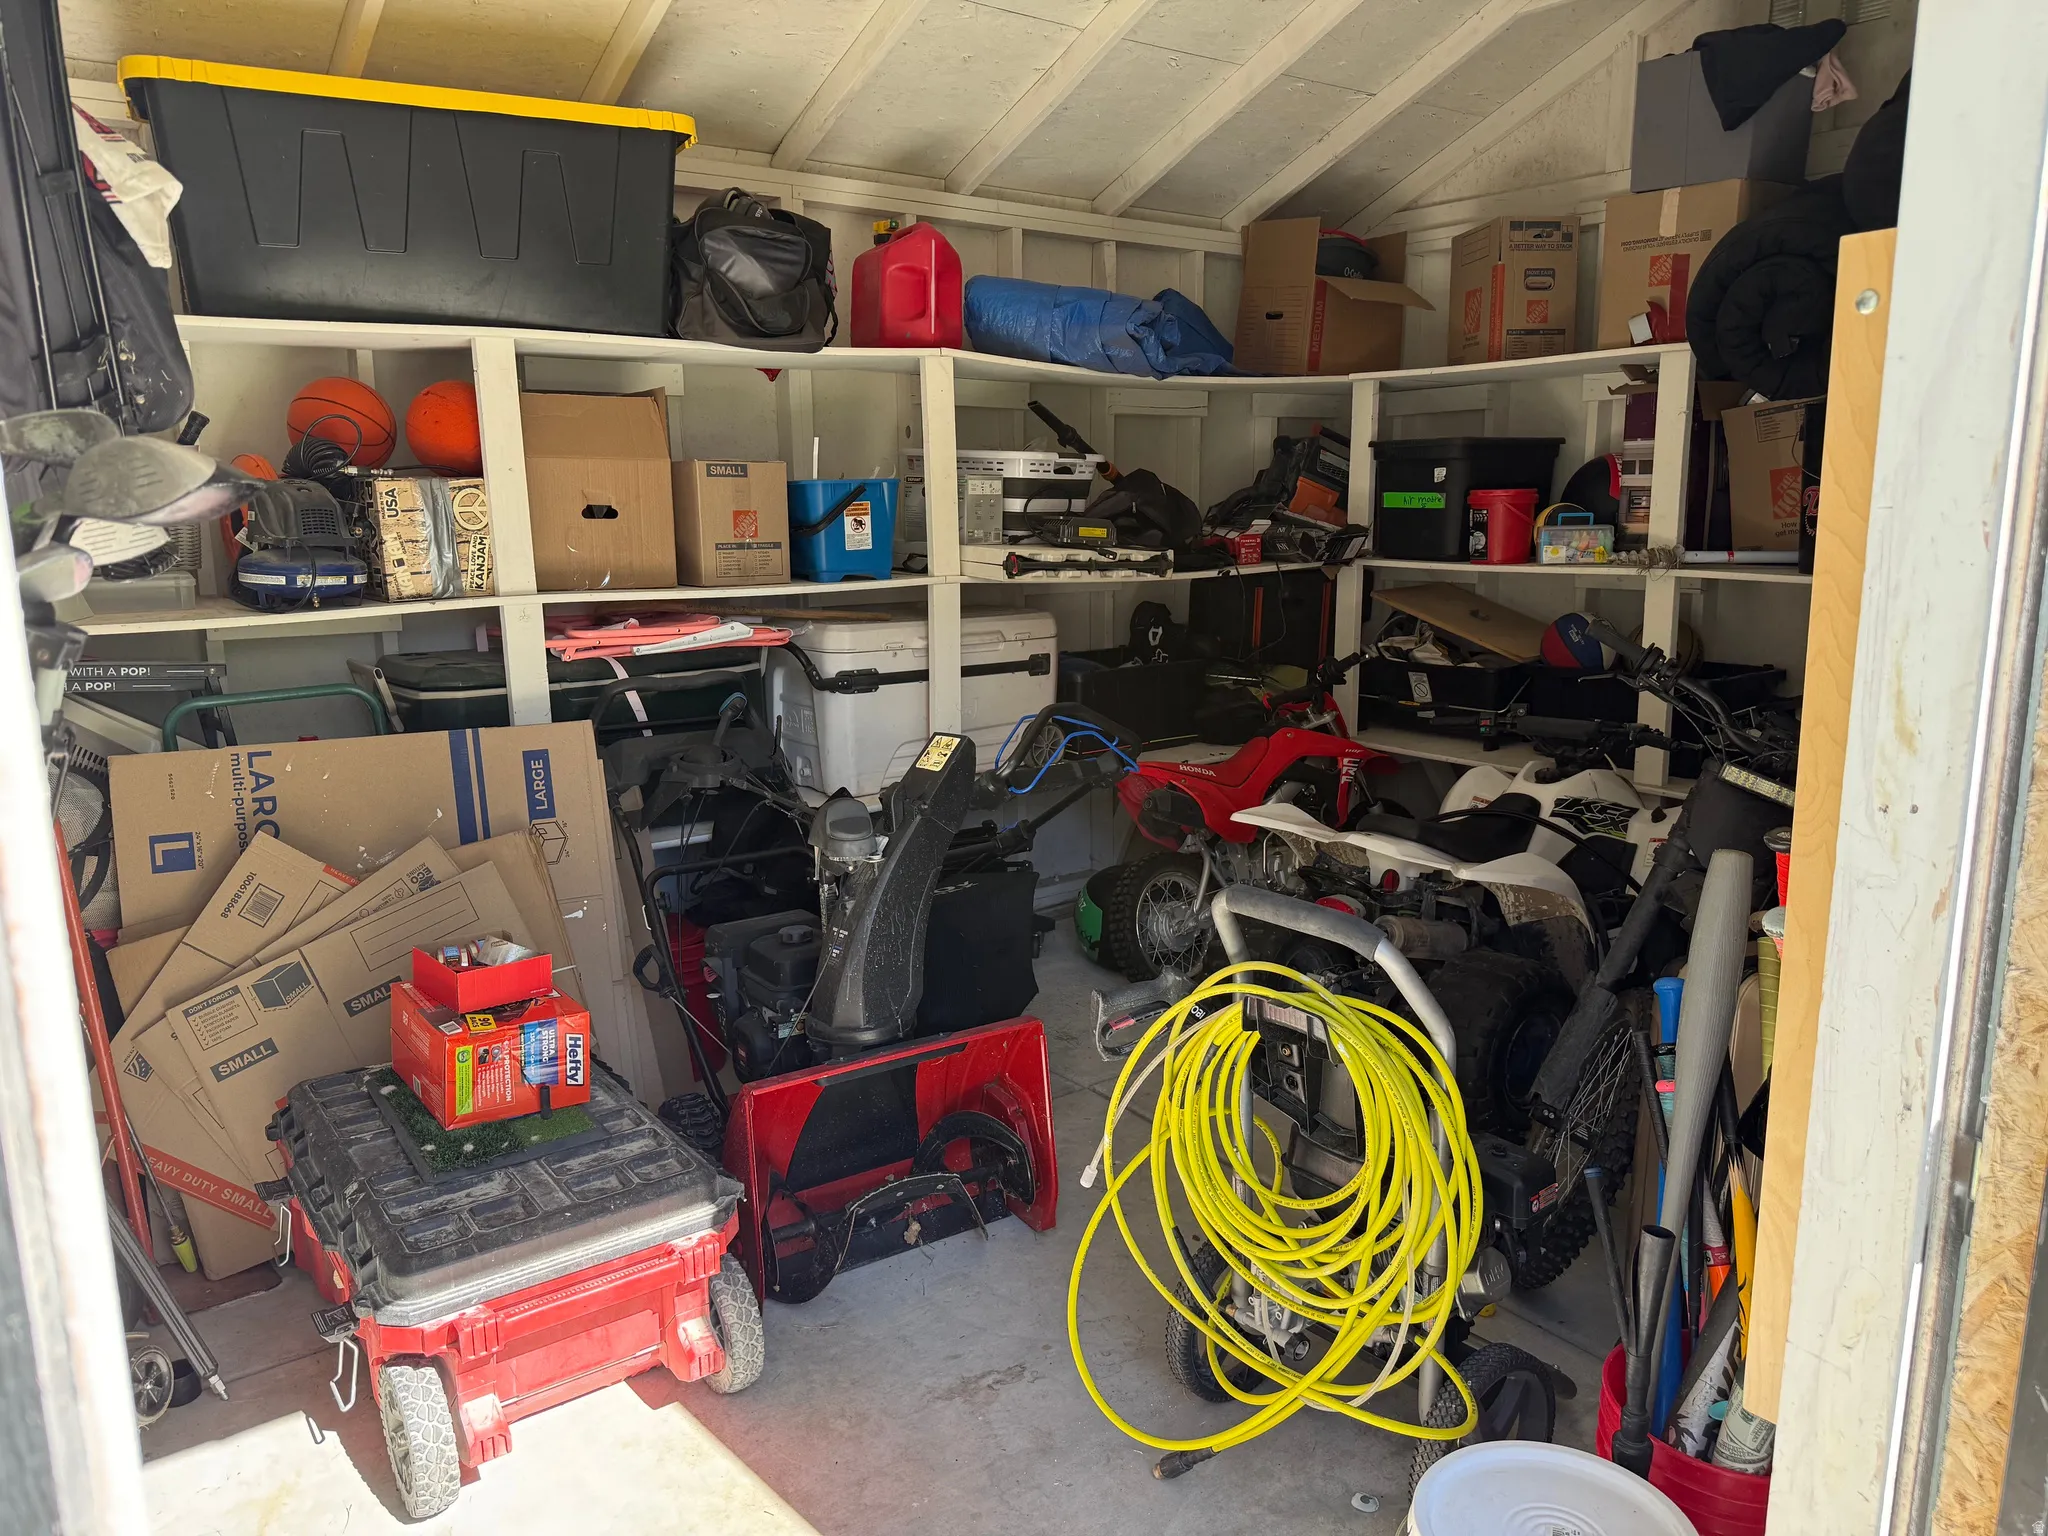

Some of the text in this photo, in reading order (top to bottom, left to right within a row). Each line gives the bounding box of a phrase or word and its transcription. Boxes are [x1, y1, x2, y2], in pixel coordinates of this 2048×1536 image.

[1527, 300, 1549, 323] HOME
[1312, 301, 1323, 352] MEDIUM
[710, 465, 744, 475] SMALL
[385, 487, 400, 519] USA
[475, 536, 487, 589] KANJAM
[70, 667, 150, 676] WITH A POP!
[72, 682, 116, 691] A POP!
[1179, 764, 1217, 777] HONDA
[1341, 757, 1361, 784] CRF
[247, 751, 280, 839] LARG
[531, 759, 548, 810] LARGE
[154, 840, 190, 866] L
[410, 867, 432, 884] ECO
[221, 871, 257, 919] 1006188668
[285, 982, 309, 1003] SMALL
[469, 1016, 479, 1028] BAGS
[477, 1016, 492, 1028] 90
[218, 1045, 272, 1076] SMALL
[567, 1036, 583, 1083] Hefty
[504, 1053, 512, 1102] PROTECTION
[148, 1157, 271, 1219] EAVY DUTY SMALL
